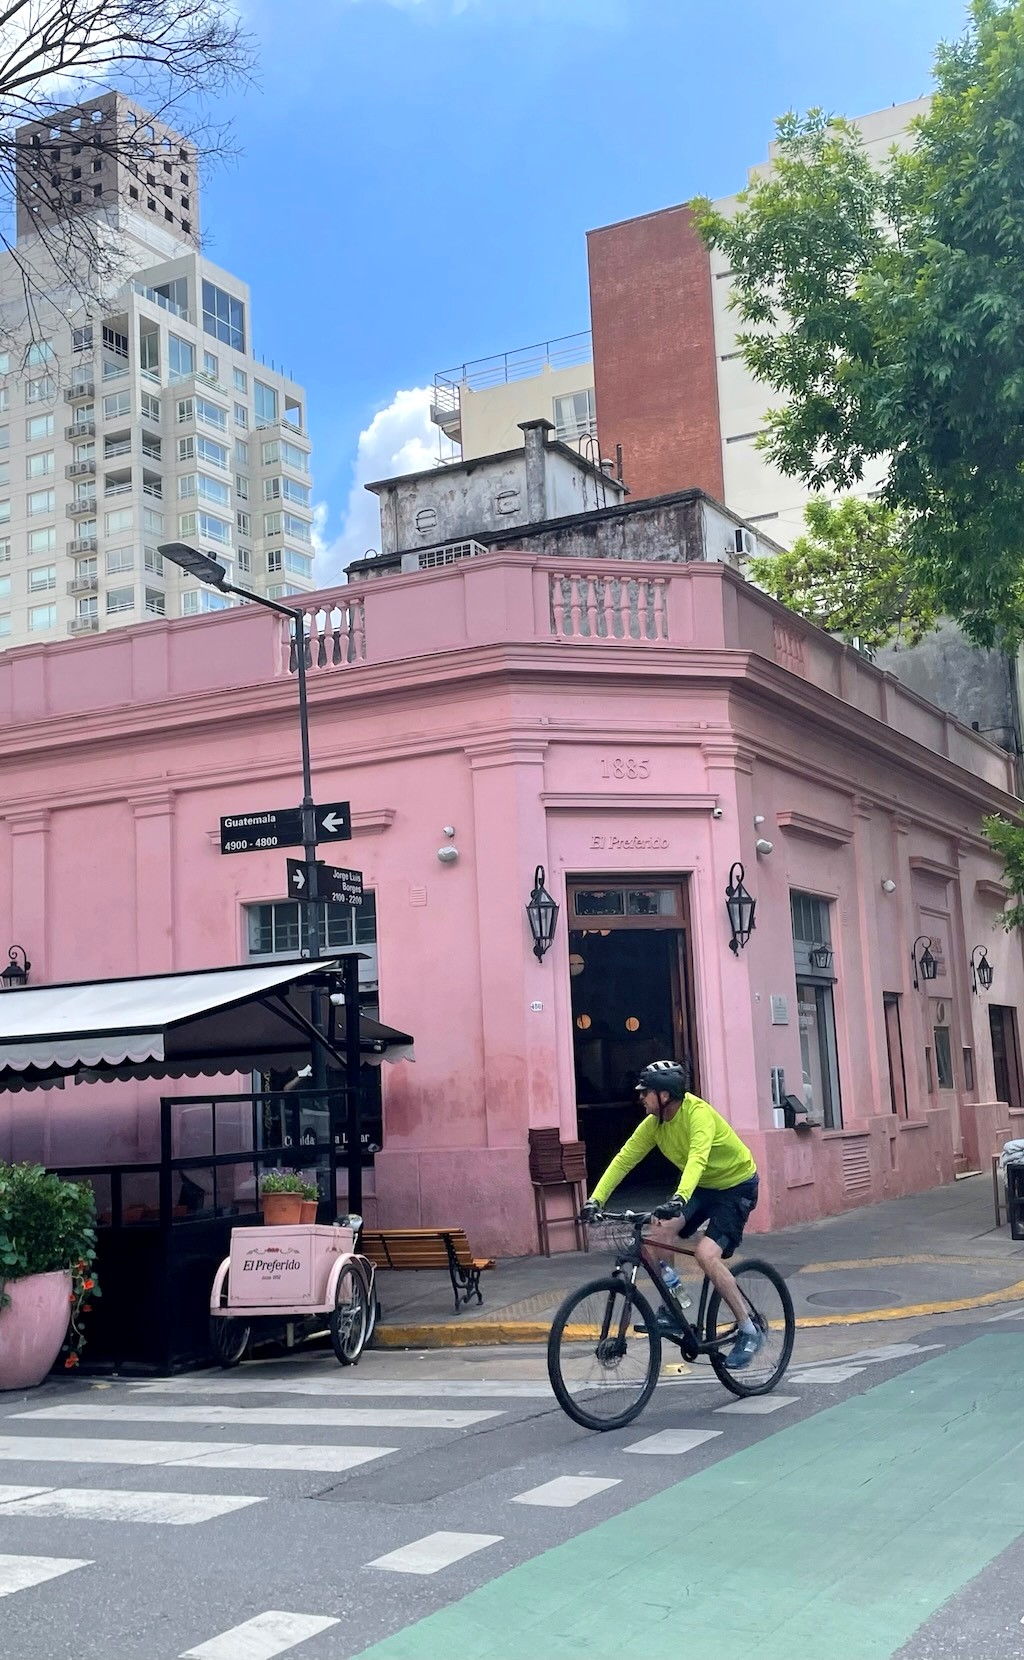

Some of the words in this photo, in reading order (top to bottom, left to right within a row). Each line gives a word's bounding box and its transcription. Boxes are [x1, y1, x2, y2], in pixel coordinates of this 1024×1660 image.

[600, 758, 650, 780] 1885
[224, 813, 276, 827] Guatemala
[224, 839, 248, 851] 4900
[254, 836, 278, 848] 4800
[589, 836, 605, 849] El
[608, 836, 669, 849] Preferido
[332, 869, 349, 882] Jorge
[349, 871, 361, 883] Luis
[342, 881, 361, 894] Borges
[331, 892, 345, 903] 2100
[348, 895, 363, 906] 2200
[243, 1260, 255, 1271] El
[255, 1259, 301, 1273] Preferido
